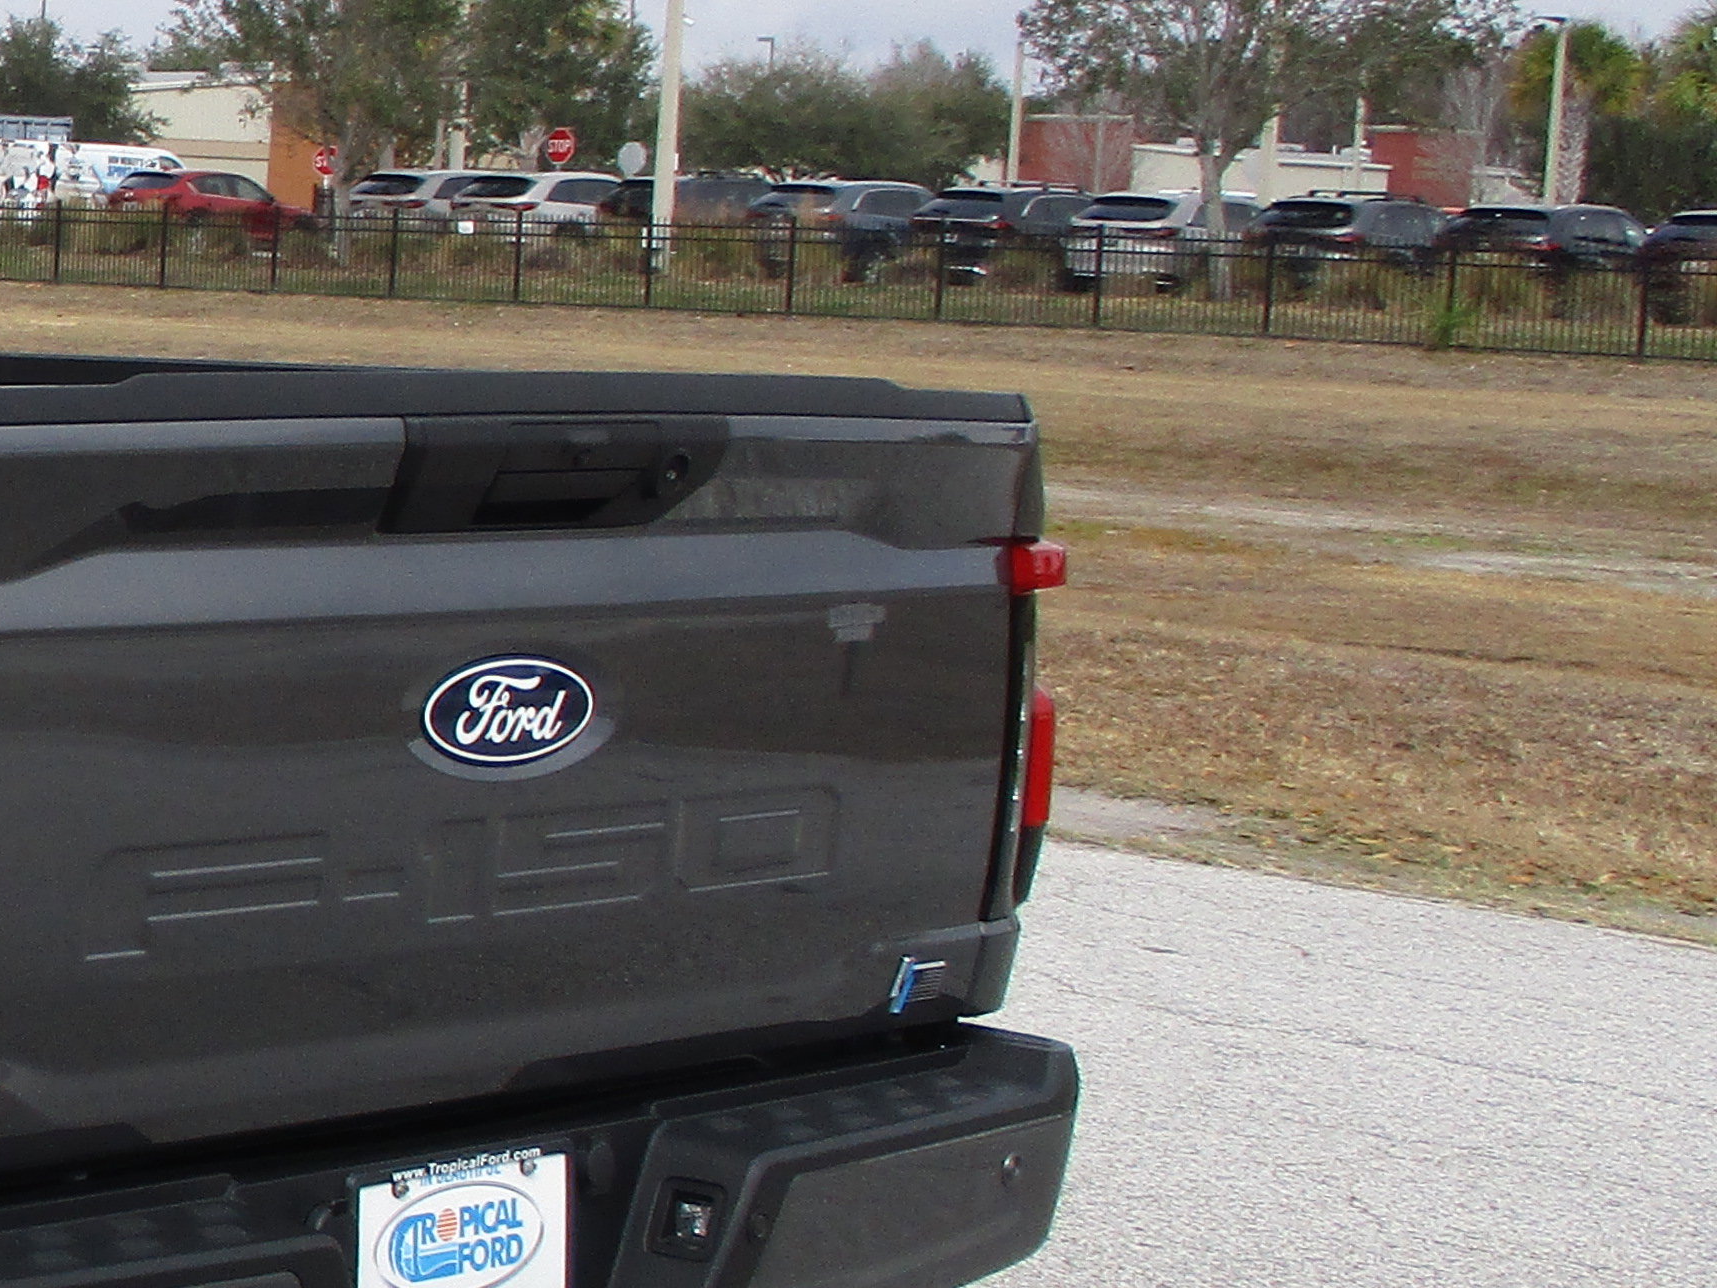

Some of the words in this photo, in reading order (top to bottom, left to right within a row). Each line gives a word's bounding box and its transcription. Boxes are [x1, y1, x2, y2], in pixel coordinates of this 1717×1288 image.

[548, 139, 571, 153] STOP
[455, 675, 567, 745] Ford
[392, 1146, 541, 1182] www.TropicalFord.com
[412, 1197, 523, 1246] TROPICAL
[458, 1233, 524, 1274] FORD
